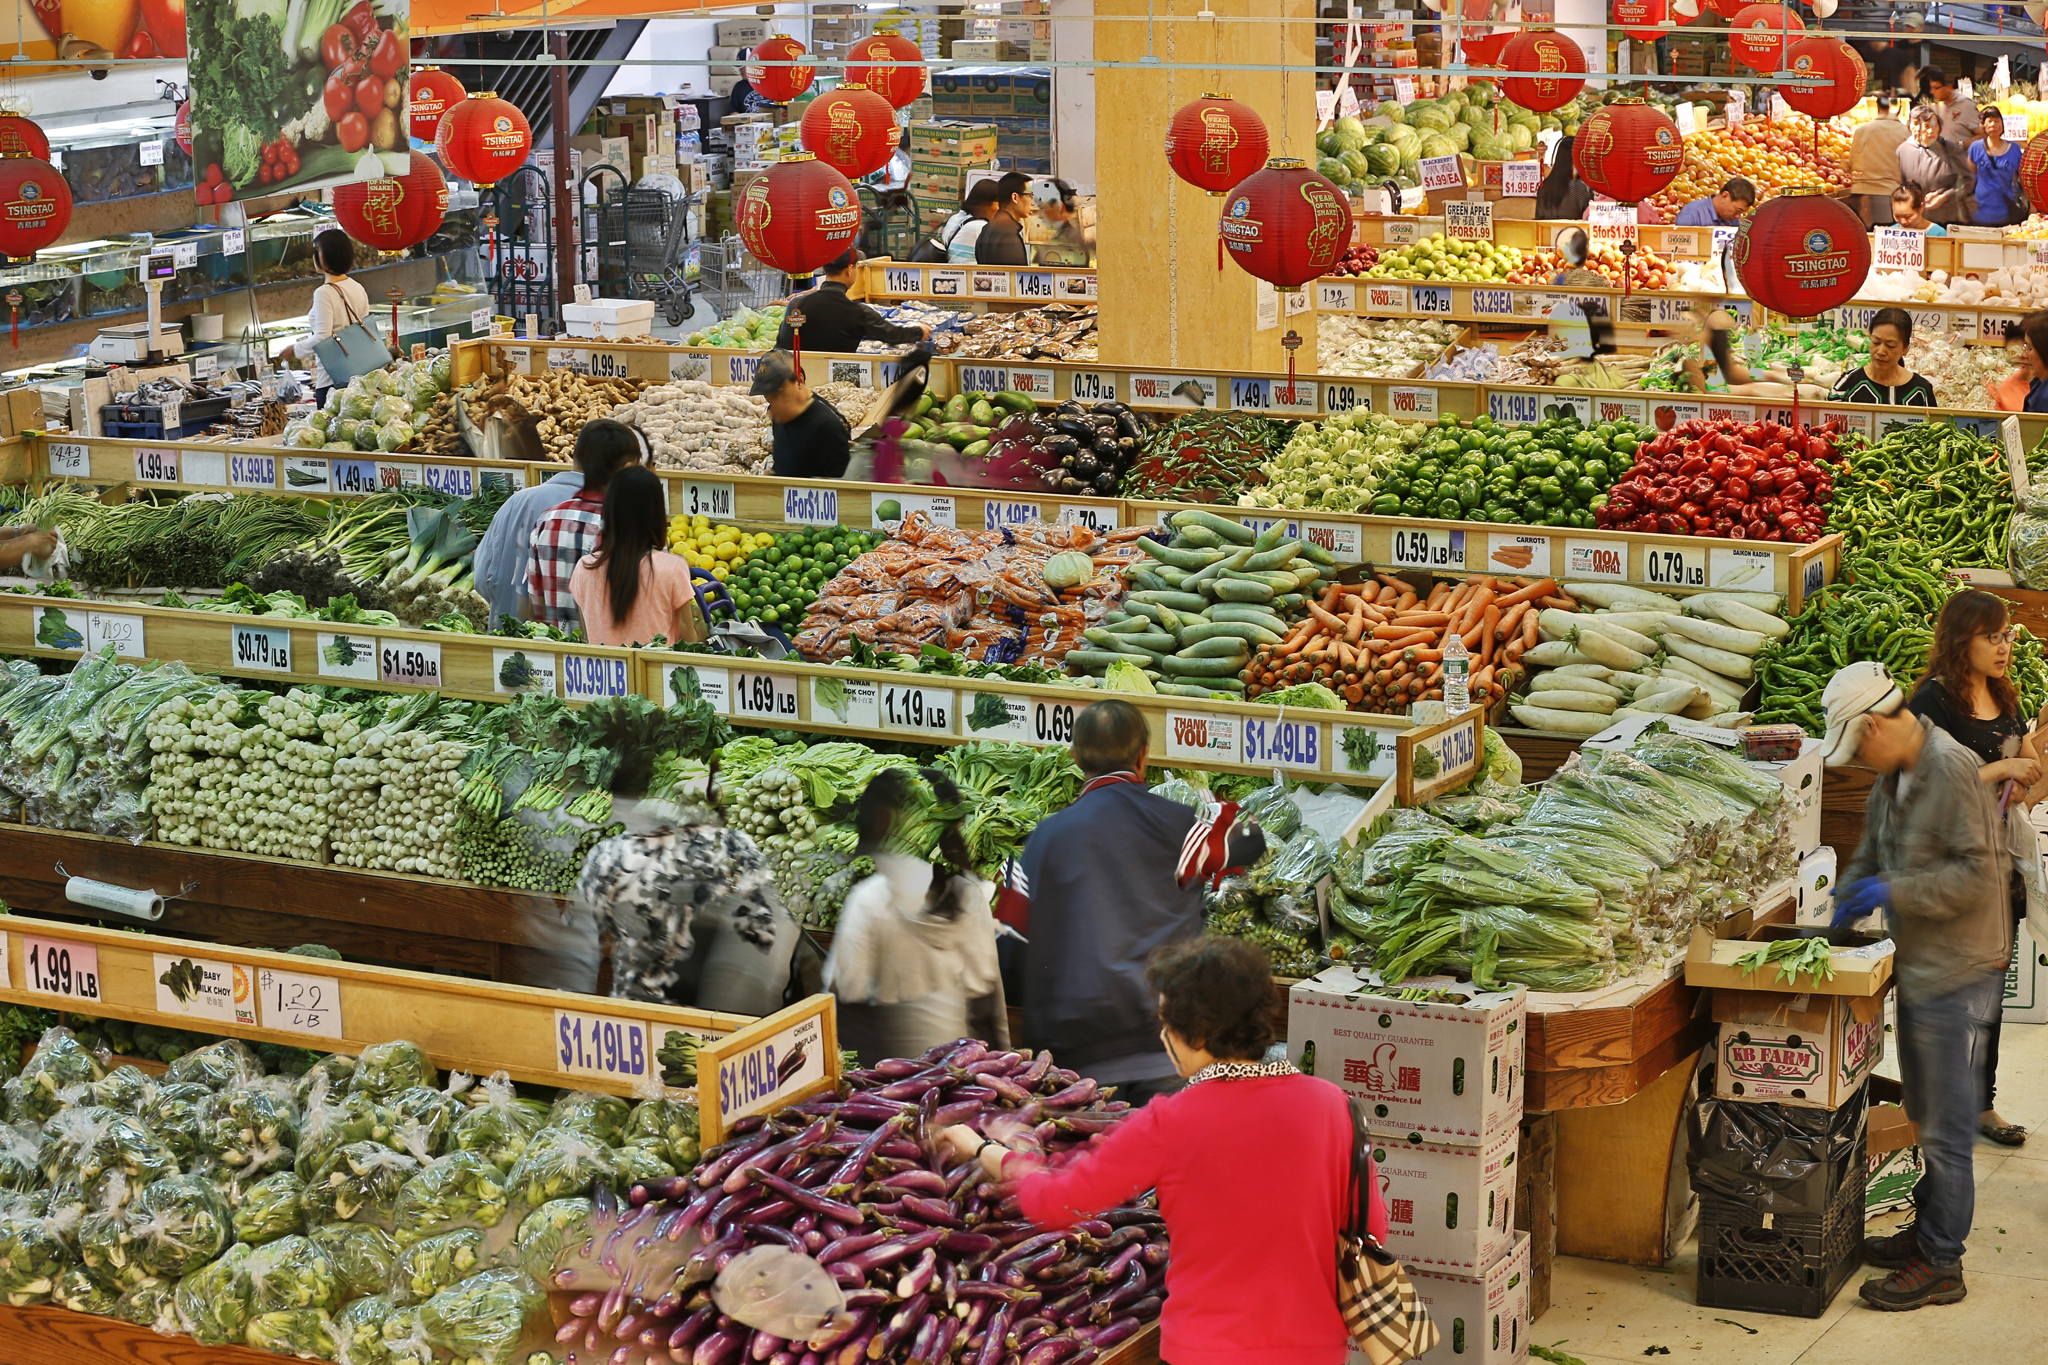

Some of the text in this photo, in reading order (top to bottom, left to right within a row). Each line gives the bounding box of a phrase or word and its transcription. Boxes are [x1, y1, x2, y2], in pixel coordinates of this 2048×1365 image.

[1743, 33, 1777, 43] TSINGTAO
[834, 111, 853, 119] YEAR
[485, 135, 523, 146] TSINGTAO
[914, 129, 959, 139] PREMIUM BANANAS
[1208, 136, 1228, 172] 蛇年
[1647, 149, 1681, 161] TSINGTAO
[1422, 157, 1453, 166] BLACKBERRY
[913, 164, 956, 175] PREMIUM BANANAS
[1508, 170, 1539, 181] 小番茄
[1424, 172, 1461, 188] $1.99/EA
[1312, 193, 1334, 203] YEAR
[1325, 201, 1337, 209] THE
[7, 204, 54, 217] TSINGTAO
[935, 201, 958, 210] BANANAS
[1316, 207, 1338, 216] SNAKE
[1448, 204, 1490, 217] GREEN APPLE
[1596, 204, 1609, 212] FUJI
[370, 193, 393, 233] 蛇年
[819, 210, 858, 226] TSINGTAO
[1448, 215, 1489, 228] 青蘋果
[1318, 219, 1338, 259] 蛇年
[1448, 225, 1490, 239] 3FOR$1.99
[1593, 224, 1636, 241] 5for$1.99
[1885, 230, 1917, 238] PEAR
[1881, 238, 1920, 252] 鴨梨
[1788, 257, 1847, 273] TSINGTAO
[1877, 250, 1922, 267] 3for$1.00
[888, 271, 908, 292] 1.19
[1019, 275, 1040, 296] 1.49
[1370, 289, 1389, 297] THANK
[1370, 295, 1389, 306] YOU
[1414, 289, 1437, 312] 1.29
[1473, 289, 1513, 315] $3.29EA
[592, 353, 627, 378] 0.99 /LB
[963, 366, 1006, 394] $0.99LB
[1012, 373, 1034, 382] THANK
[1134, 378, 1156, 387] THANK
[1013, 380, 1034, 391] YOU
[1074, 372, 1114, 400] 0.79 /LB
[1135, 386, 1156, 398] YOU
[1234, 382, 1260, 407] 1.49
[1328, 385, 1355, 411] 0.99
[1393, 392, 1416, 401] THANK
[1393, 400, 1417, 411] YOU
[1490, 393, 1537, 423] $1.19LB
[1599, 402, 1624, 412] THANK
[1708, 408, 1732, 418] THANK
[1824, 413, 1849, 424] THANK
[138, 452, 176, 481] 1.99 /LB
[232, 455, 275, 485] $1.99LB
[379, 467, 401, 476] THANK
[335, 464, 375, 493] 1.49 /LB
[426, 466, 472, 498] $2.49LB
[690, 486, 730, 516] 3 FOR $1.00
[786, 489, 836, 524] 4For$1.00
[1307, 527, 1335, 538] THANK
[1396, 530, 1448, 564] 0.59 /LB
[1516, 536, 1546, 544] CARROTS
[1592, 549, 1619, 565] YOU
[1751, 550, 1771, 558] RADISH
[1592, 563, 1621, 575] THANK
[1648, 550, 1704, 585] 0.79 /LB
[55, 638, 82, 649] Spinach
[238, 630, 288, 667] $0.79 /LB
[530, 668, 554, 677] CHOY SUM
[565, 654, 627, 698] $0.99/LB
[846, 679, 871, 687] TAIWAN
[738, 674, 796, 714] 1.69 /LB
[842, 687, 876, 697] BOK CHOY
[885, 688, 946, 728] 1.19 /LB
[1000, 703, 1026, 712] MUSTARD
[1019, 714, 1027, 723] (S)
[1036, 702, 1074, 743] 0.69
[1174, 717, 1207, 731] THANK
[1174, 728, 1207, 748] YOU
[1245, 717, 1318, 764] $1.49LB
[1442, 720, 1475, 778] $0.79LB
[30, 943, 98, 998] 1.99 /LB
[203, 970, 222, 981] BABY
[213, 986, 232, 997] CHOY
[293, 1013, 321, 1028] LB
[793, 1020, 815, 1038] CHINESE
[559, 1012, 645, 1076] $1.19LB
[1333, 1028, 1435, 1047] BEST QUALITY GUARANTEE
[1732, 1046, 1812, 1069] KB FARM
[720, 1043, 778, 1117] $1.19LB
[1343, 1058, 1421, 1093] 華 騰
[1357, 1091, 1423, 1106] Teng Produce Ltd
[1373, 1118, 1416, 1131] VEGETABLES
[1381, 1167, 1428, 1180] GUARANTEE
[1390, 1198, 1414, 1225] 騰
[1402, 1229, 1416, 1238] Ltd
